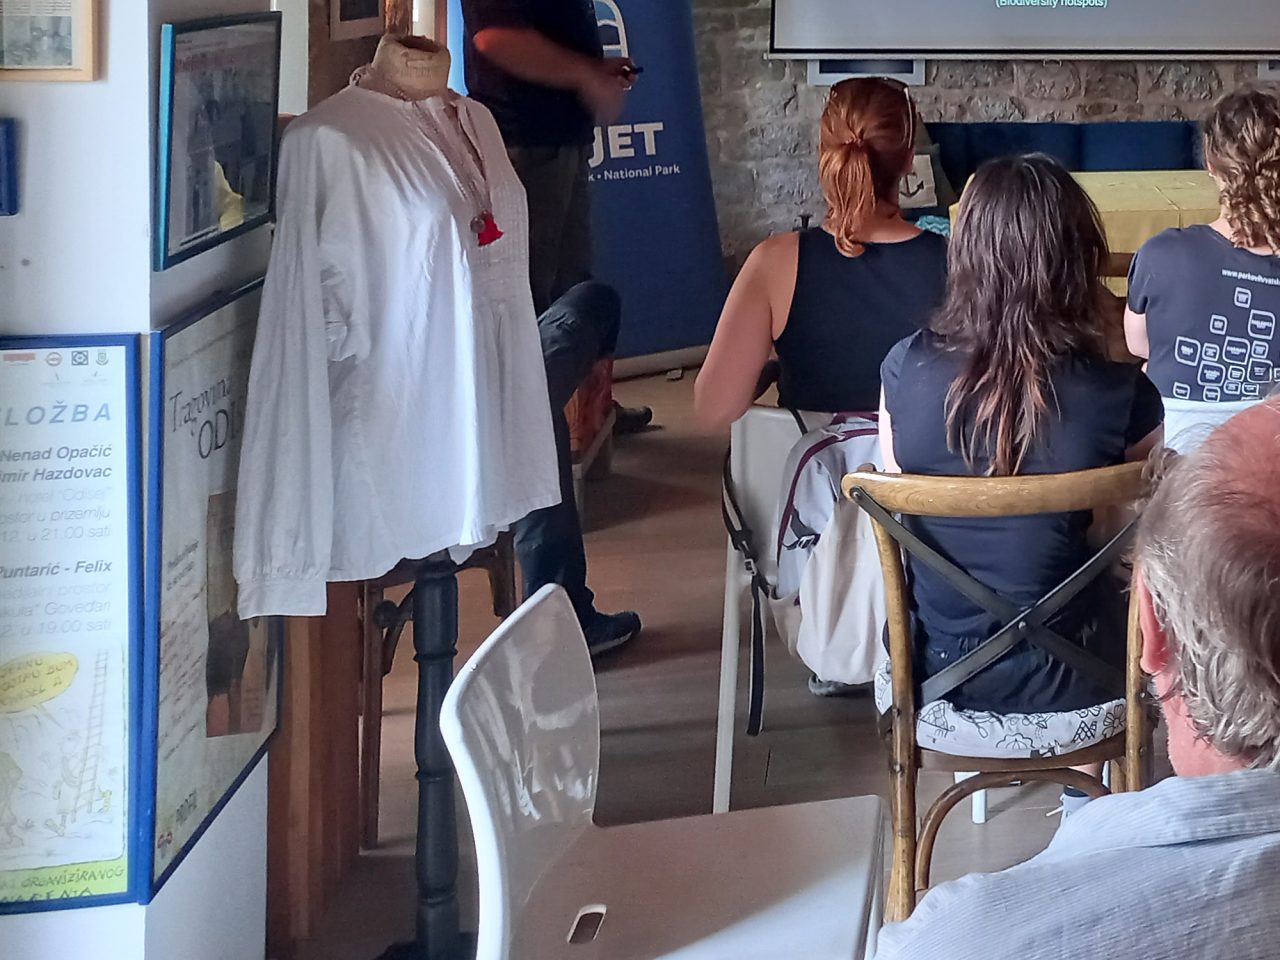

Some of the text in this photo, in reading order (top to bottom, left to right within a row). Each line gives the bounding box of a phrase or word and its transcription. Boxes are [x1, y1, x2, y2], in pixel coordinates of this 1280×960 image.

[588, 122, 664, 168] JET
[604, 165, 653, 181] National
[655, 164, 681, 176] Park
[0, 400, 111, 426] LOŽBA
[57, 443, 112, 461] Opačić
[33, 467, 112, 481] Hazdovac
[74, 559, 112, 574] Felix
